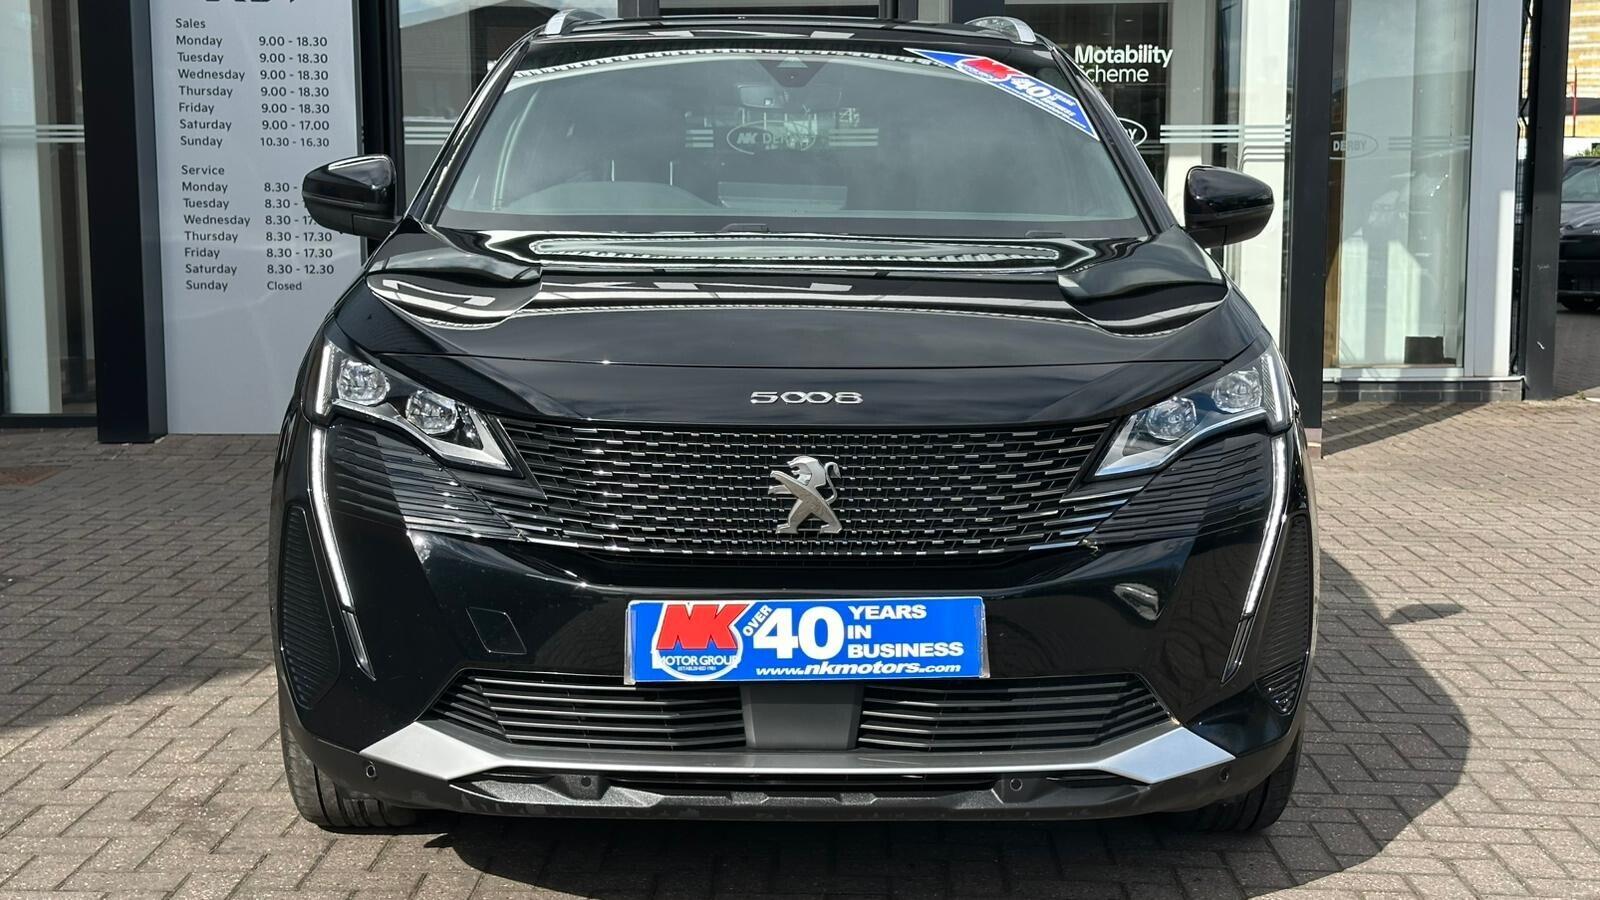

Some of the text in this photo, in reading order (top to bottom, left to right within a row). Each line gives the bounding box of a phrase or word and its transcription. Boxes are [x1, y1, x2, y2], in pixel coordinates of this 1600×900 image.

[176, 18, 206, 29] Sales
[176, 35, 223, 49] Monday
[259, 36, 285, 47] 9.00
[297, 36, 328, 47] 18.30
[177, 52, 224, 65] Tuesday
[259, 53, 286, 64] 9.00
[297, 53, 329, 64] 18.30
[1075, 44, 1174, 68] Motability
[178, 69, 246, 82] Wednesday
[260, 69, 287, 80] 9.00
[298, 70, 329, 81] 18.30
[1080, 65, 1150, 83] cheme
[178, 85, 233, 99] Thursday
[261, 87, 287, 97] 9.00
[298, 87, 329, 97] 18.30
[179, 102, 215, 116] Friday
[261, 103, 287, 114] 9.00
[299, 103, 330, 114] 18.30
[179, 118, 232, 132] Saturday
[262, 119, 288, 130] 9.00
[299, 120, 330, 131] 17.00
[180, 135, 223, 149] Sunday
[261, 136, 290, 147] 10.30
[301, 137, 330, 148] 16.30
[1333, 140, 1367, 152] DERBY
[182, 165, 225, 176] Service
[182, 182, 229, 195] Monday
[264, 182, 290, 192] 8.30
[183, 198, 230, 211] Tuesday
[265, 198, 291, 209] 8.30
[184, 214, 251, 227] Wednesday
[265, 215, 291, 225] 8.30
[184, 230, 239, 244] Thursday
[266, 231, 292, 242] 8.30
[303, 231, 333, 242] 17.30
[185, 247, 221, 260] Friday
[266, 248, 292, 258] 8.30
[304, 248, 333, 258] 17.30
[185, 263, 238, 276] Saturday
[267, 264, 293, 274] 8.30
[304, 264, 335, 275] 12.30
[186, 280, 303, 293] Sunday Closed
[750, 391, 864, 404] 5008
[848, 605, 927, 620] YEARS
[656, 604, 750, 650] NK
[743, 605, 772, 637] OVER
[753, 606, 845, 660] 40
[848, 625, 872, 639] IN
[848, 641, 964, 659] BUSINESS
[659, 655, 739, 666] MOTOR GROUP
[756, 660, 962, 677] www.nkmotors.com
